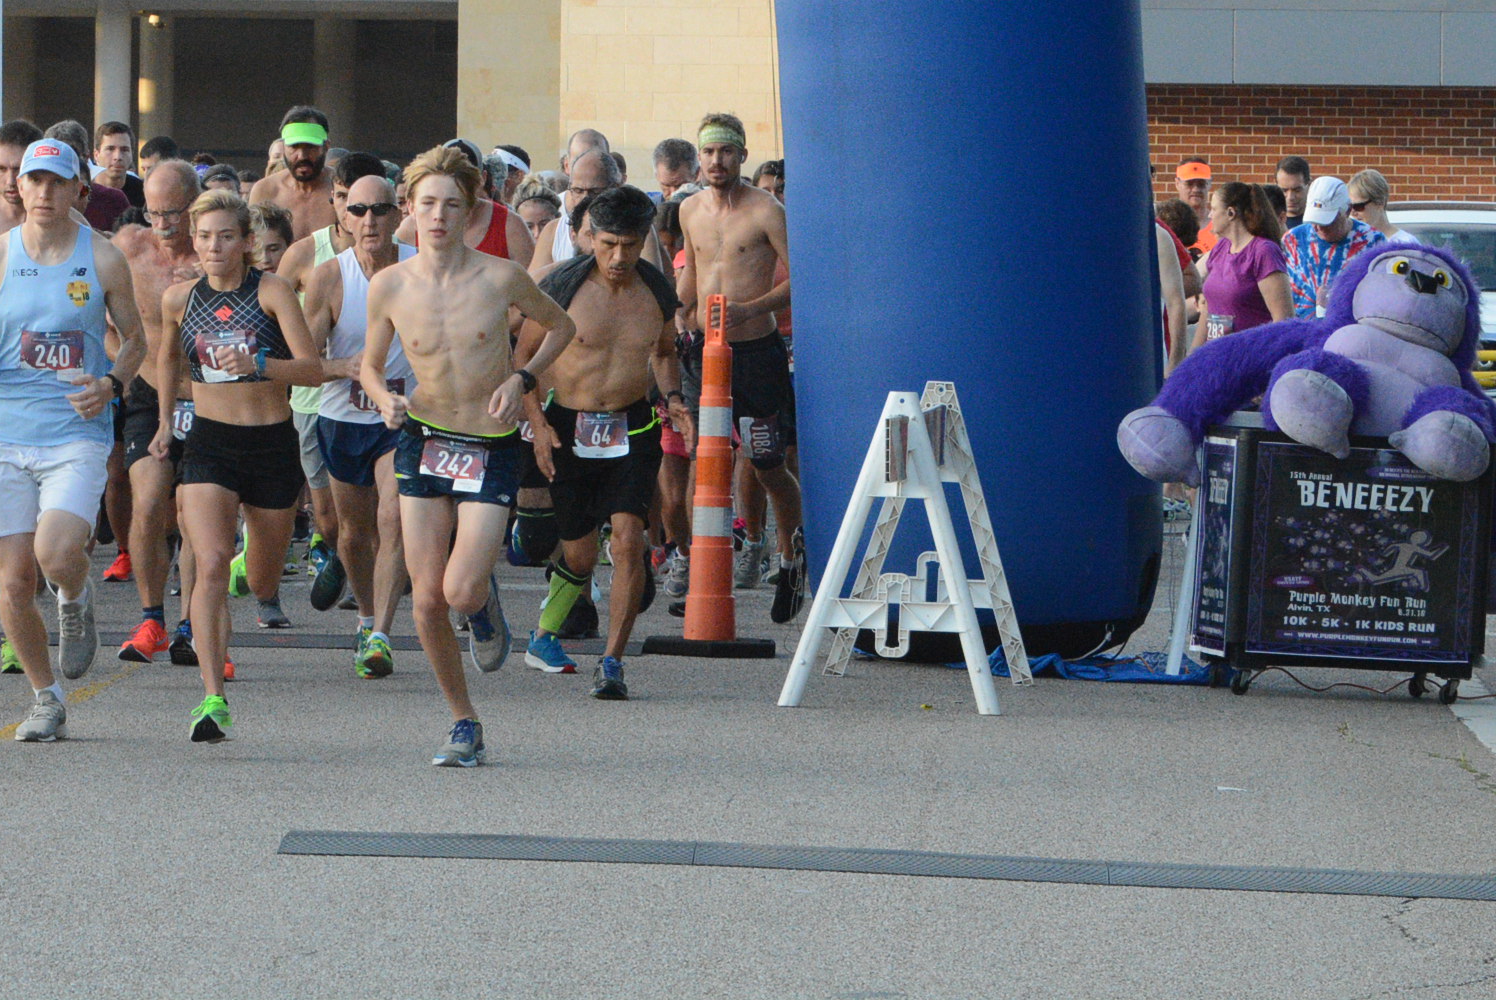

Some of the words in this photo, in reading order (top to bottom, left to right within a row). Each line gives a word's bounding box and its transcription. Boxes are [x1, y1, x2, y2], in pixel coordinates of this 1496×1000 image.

[1206, 322, 1225, 339] 283
[34, 344, 70, 367] 240
[591, 424, 612, 445] 64
[434, 450, 474, 478] 242
[1289, 471, 1307, 480] 15th
[1308, 472, 1333, 481] Annual
[1296, 480, 1435, 513] BENEEEZY
[1289, 590, 1326, 604] Purple
[1330, 592, 1376, 609] Monkey
[1380, 595, 1400, 607] Fun
[1404, 596, 1427, 609] Run
[1283, 616, 1307, 626] 10K
[1321, 618, 1340, 628] 5K
[1355, 620, 1371, 630] 1K
[1374, 621, 1404, 632] KIDS
[1408, 622, 1435, 633] RUN
